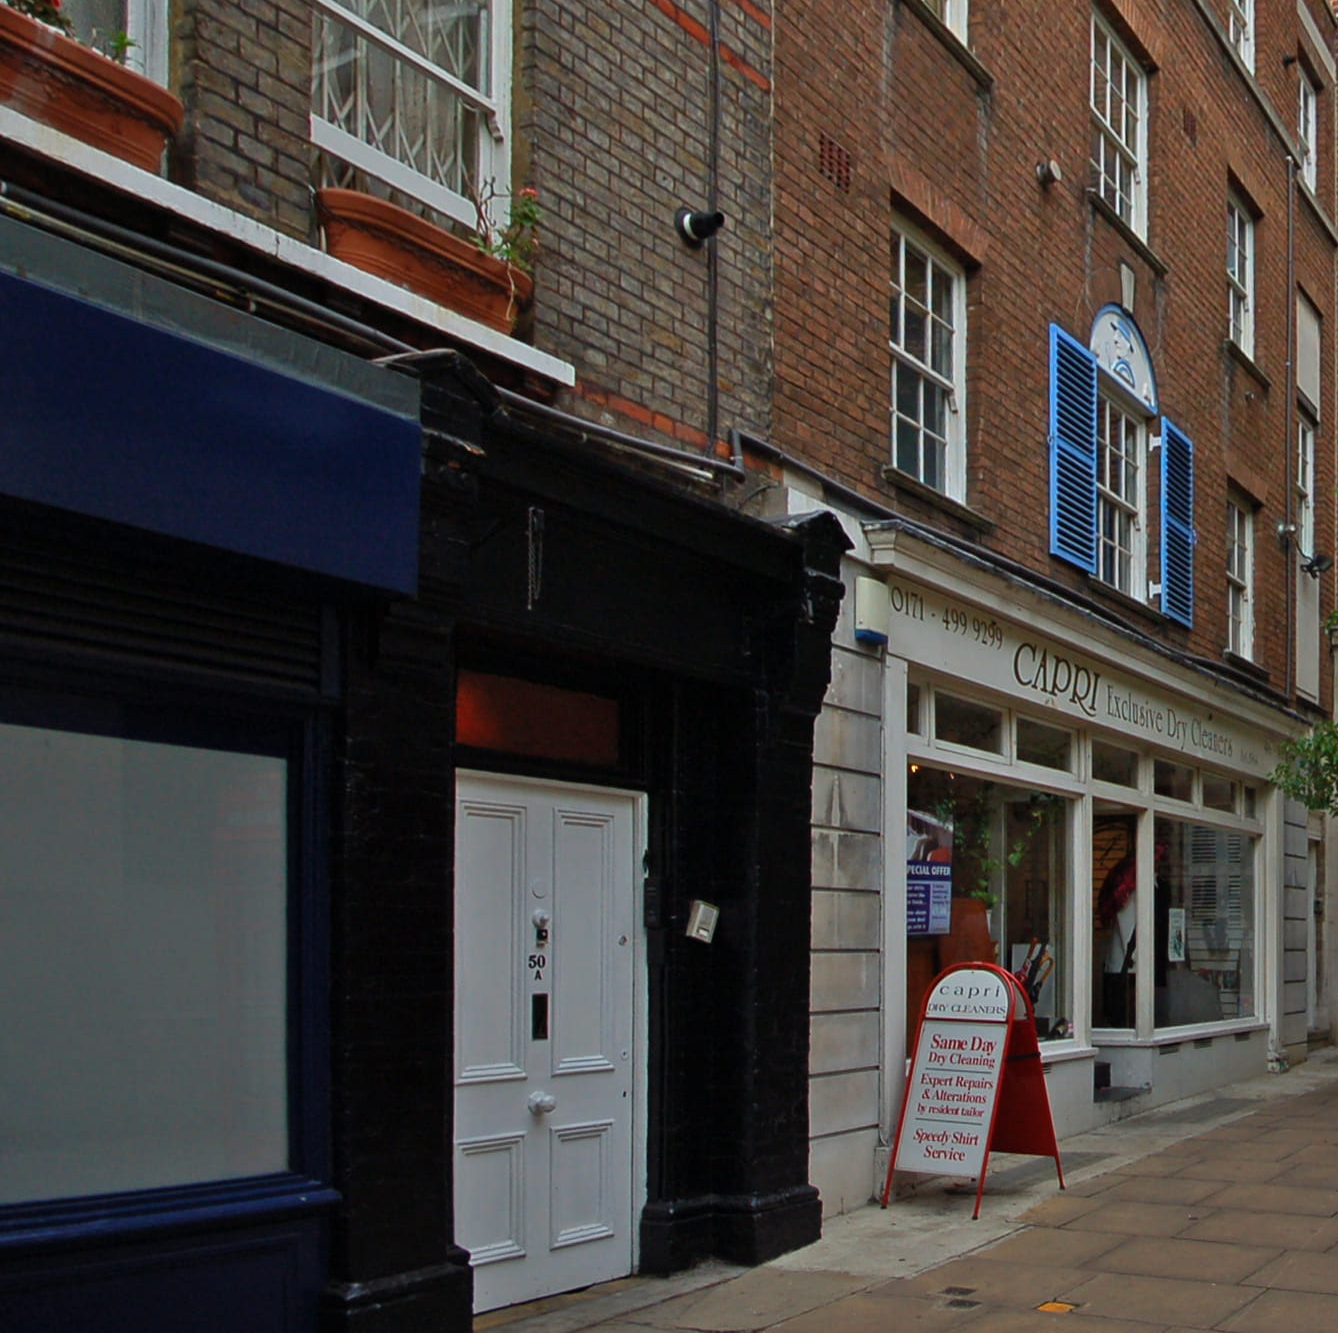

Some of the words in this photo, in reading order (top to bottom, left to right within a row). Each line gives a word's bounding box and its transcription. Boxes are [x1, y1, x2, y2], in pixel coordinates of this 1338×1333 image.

[891, 586, 924, 621] 0171
[942, 607, 968, 635] 499
[972, 618, 1003, 650] 9299
[1013, 642, 1101, 717] CAPRI
[1107, 684, 1163, 733] Exclusive
[1167, 708, 1187, 750] Dry
[1191, 717, 1234, 758] Cleaners
[907, 864, 930, 876] PECIAL
[931, 865, 951, 876] OFFER
[528, 954, 546, 969] 50
[534, 969, 542, 981] A
[939, 985, 1001, 999] capri
[928, 1002, 949, 1013] DRY
[951, 1003, 1006, 1015] CLEANERS
[930, 1033, 968, 1052] Same
[970, 1035, 997, 1056] Day
[928, 1051, 947, 1066] Dry
[949, 1052, 996, 1069] Cleaning
[921, 1073, 953, 1088] Expert
[955, 1075, 994, 1091] Repairs
[921, 1088, 931, 1100] &
[932, 1089, 987, 1104] Alterations
[917, 1102, 926, 1115] by
[928, 1104, 960, 1116] resident
[961, 1106, 985, 1118] tailor
[913, 1127, 950, 1146] Speedy
[951, 1131, 979, 1146] Shirt
[923, 1144, 966, 1162] Service
